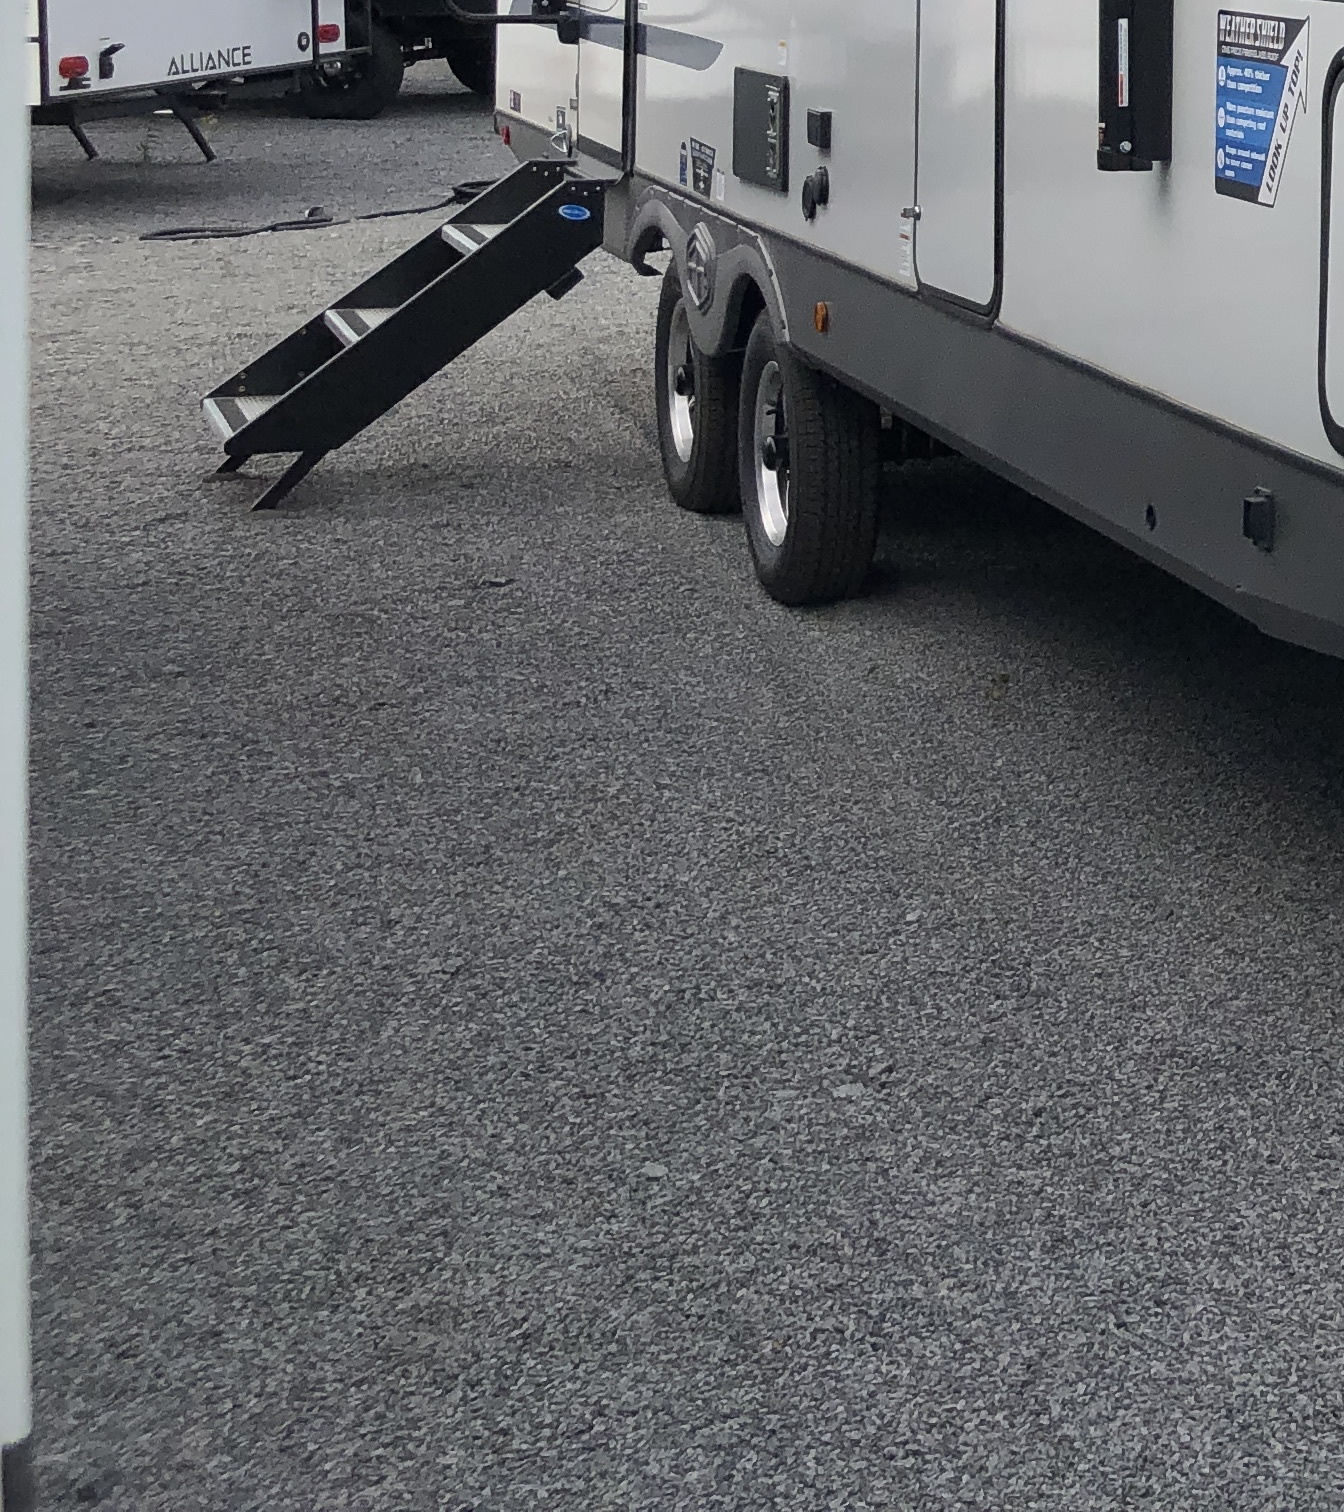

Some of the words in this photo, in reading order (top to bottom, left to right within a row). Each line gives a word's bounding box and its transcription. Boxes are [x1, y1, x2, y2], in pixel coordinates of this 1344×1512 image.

[167, 45, 252, 76] ALLIANCE
[1265, 138, 1283, 195] LOOK
[1279, 102, 1289, 134] UP
[1288, 48, 1303, 97] TOP!
